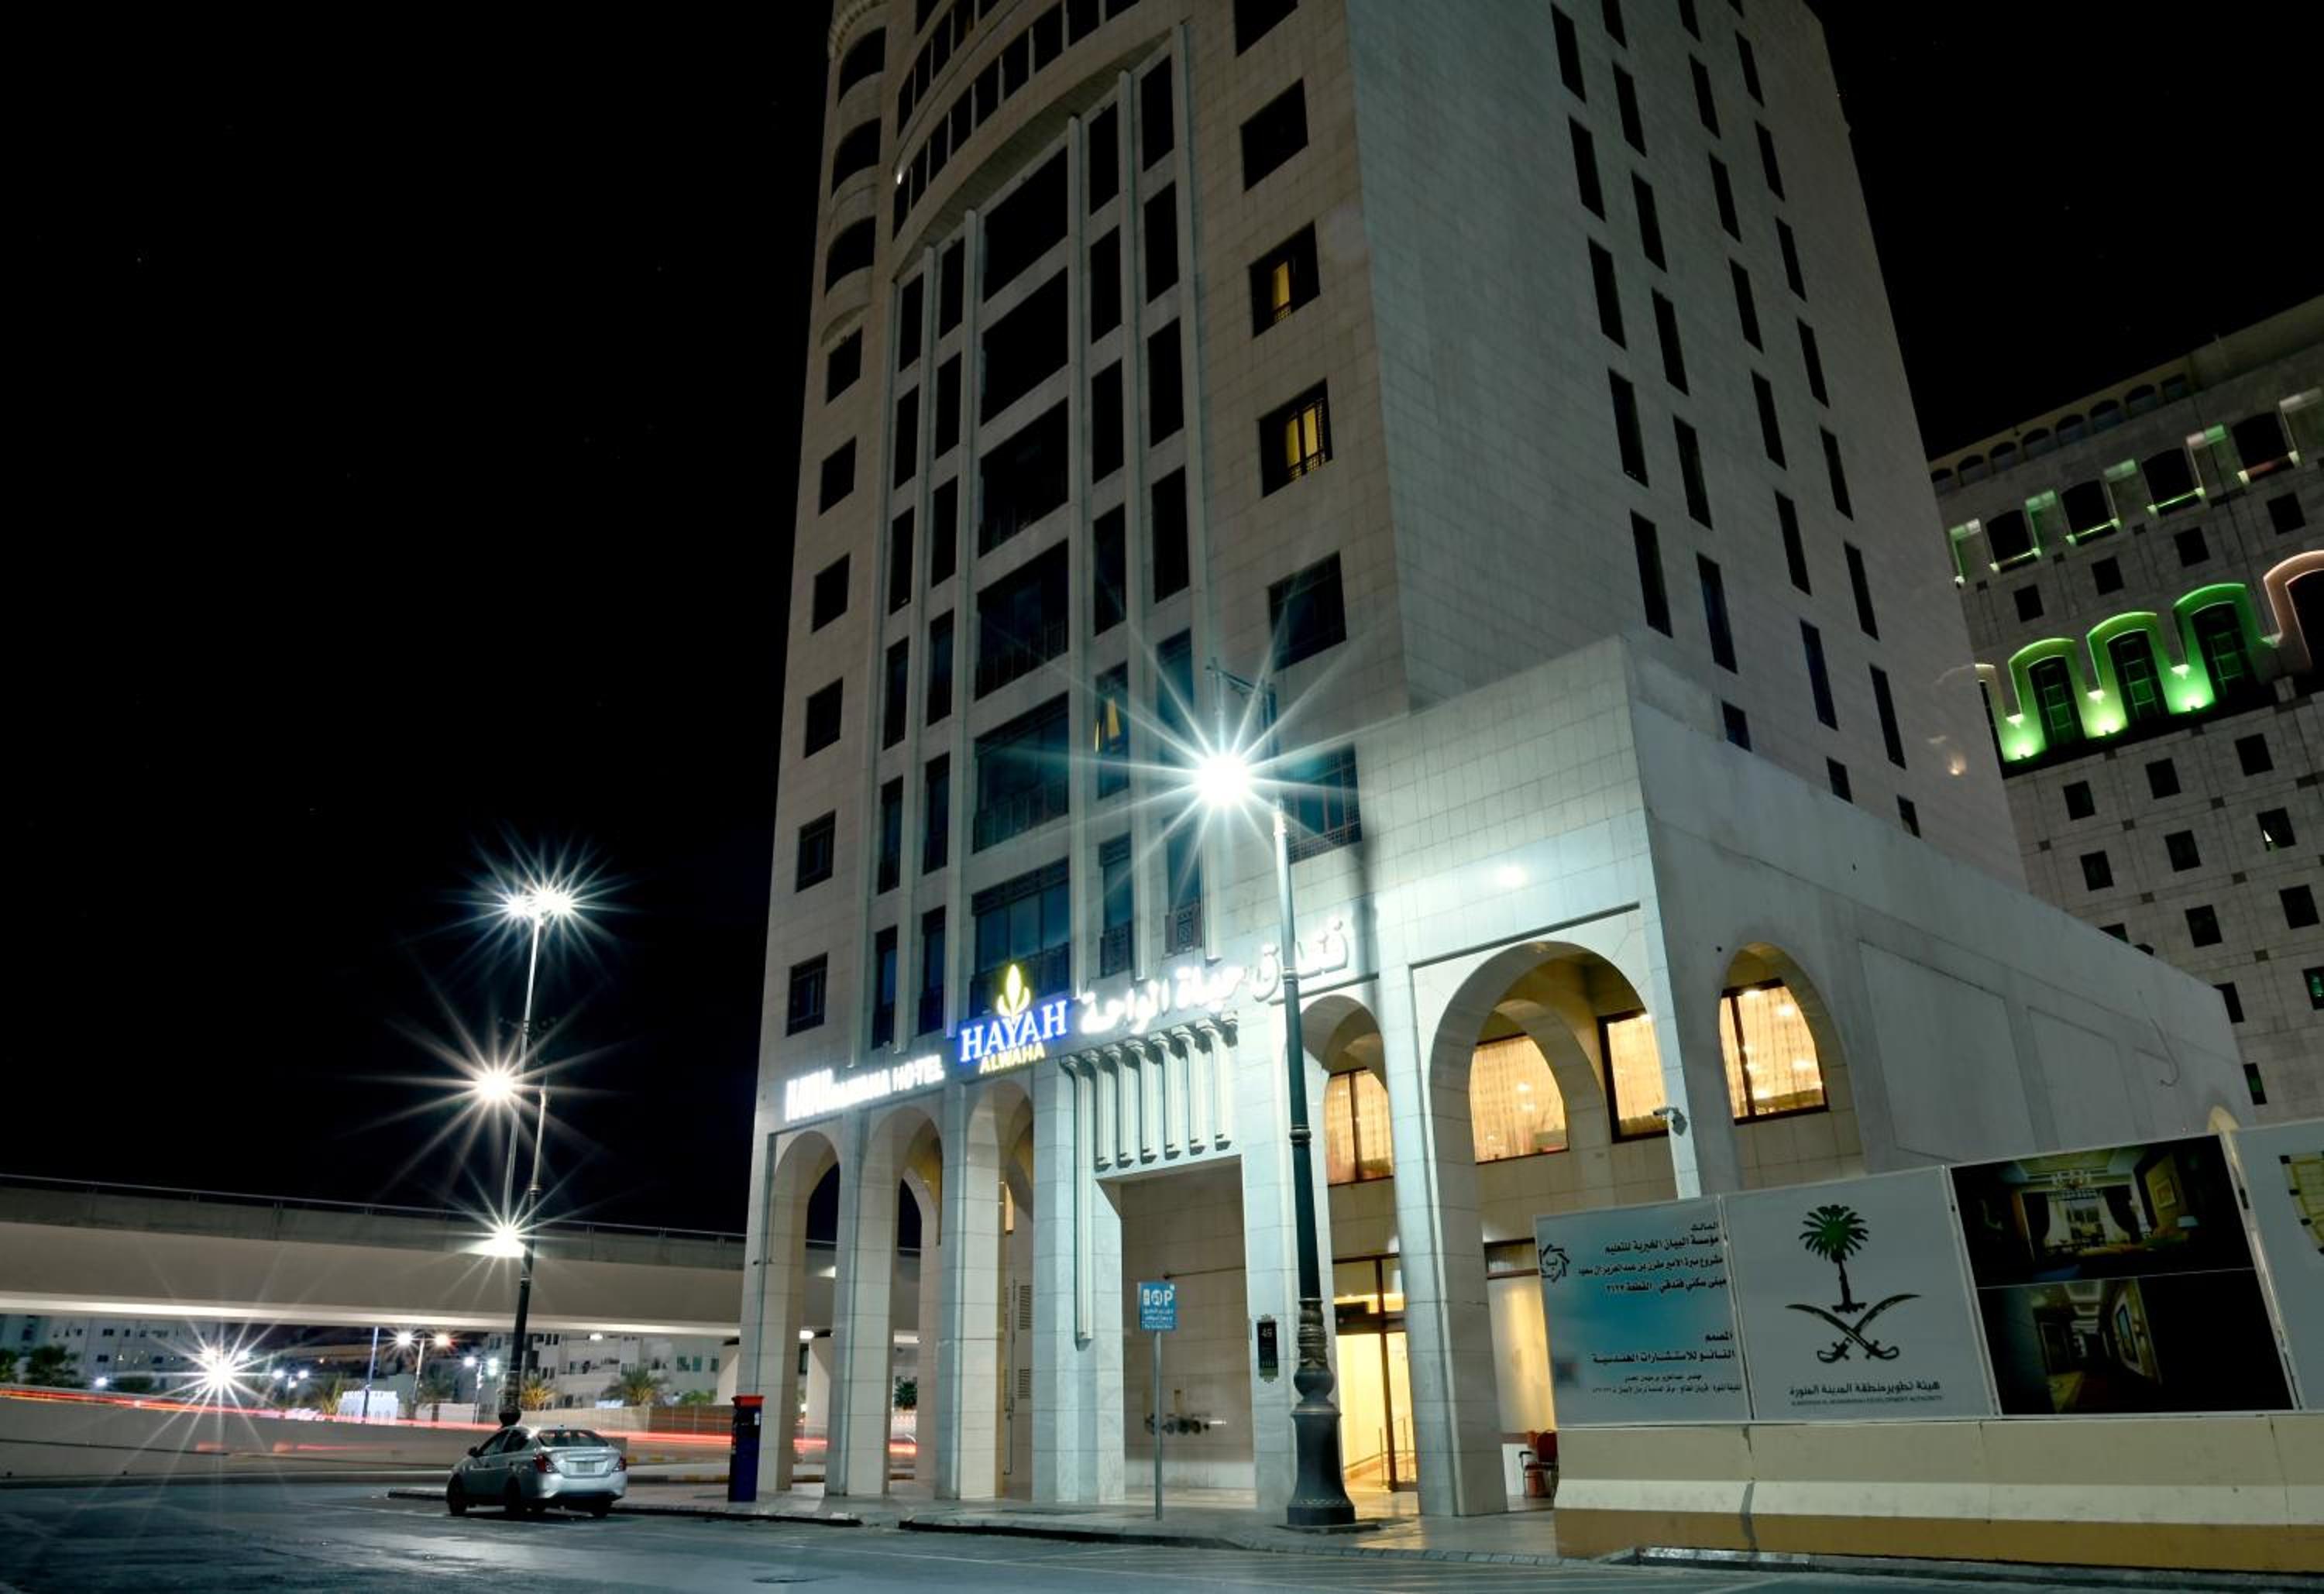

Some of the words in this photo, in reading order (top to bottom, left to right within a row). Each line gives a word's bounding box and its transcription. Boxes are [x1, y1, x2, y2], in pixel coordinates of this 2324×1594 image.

[960, 999, 1068, 1063] HAYAH
[892, 1054, 945, 1091] HOTEL
[979, 1042, 1046, 1074] ALWAHA
